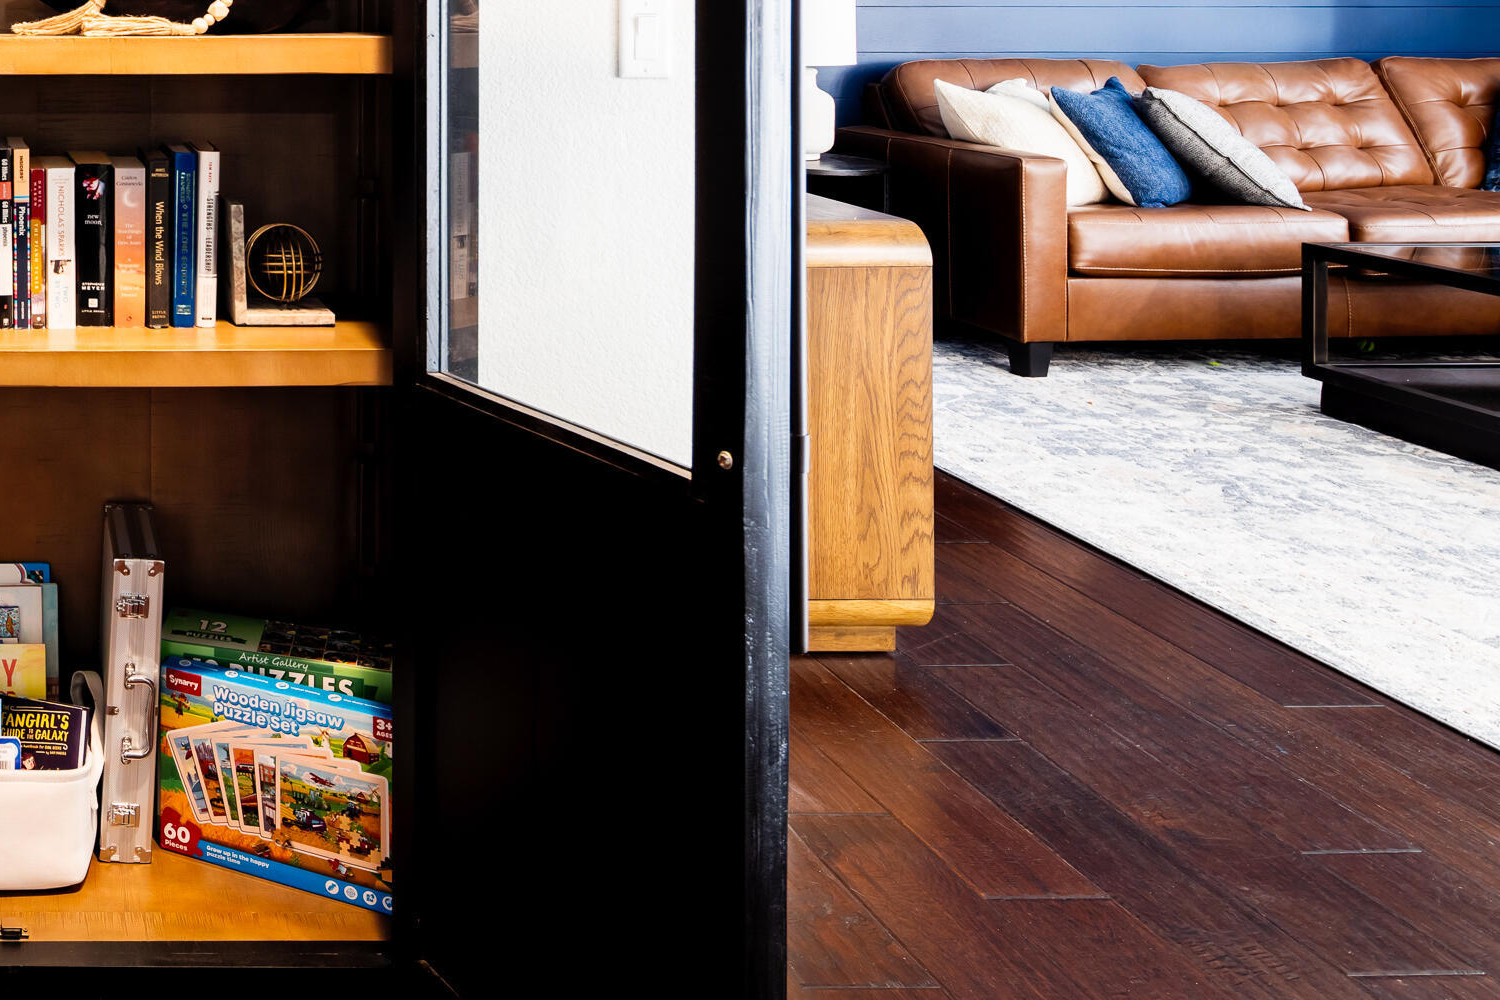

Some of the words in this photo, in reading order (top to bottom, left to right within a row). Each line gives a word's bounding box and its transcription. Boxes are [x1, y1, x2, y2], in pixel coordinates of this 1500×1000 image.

[18, 206, 26, 236] Phoenix
[155, 201, 164, 224] When
[206, 198, 214, 230] STRENGTHS
[156, 226, 164, 239] the
[156, 240, 164, 261] Wind
[204, 237, 212, 272] LEADERSHIP
[156, 262, 164, 285] Blows
[200, 620, 227, 632] 12
[239, 652, 270, 664] Artist
[271, 657, 309, 672] Gallery
[168, 674, 199, 690] Synarry
[212, 685, 280, 715] Wooden
[283, 701, 344, 730] Jigsaw
[2, 712, 70, 730] FANGIRL'S
[213, 701, 267, 727] Puzzle
[270, 716, 300, 736] Set
[376, 719, 392, 730] 3+
[2, 728, 26, 740] GUIDE
[34, 729, 69, 742] GALAXY
[376, 730, 392, 738] AGES
[163, 822, 191, 844] 60
[164, 839, 188, 852] Pieces
[206, 845, 222, 854] Grow
[239, 854, 249, 862] the
[250, 857, 270, 868] happy
[206, 852, 226, 860] puzzle
[226, 856, 241, 865] time
